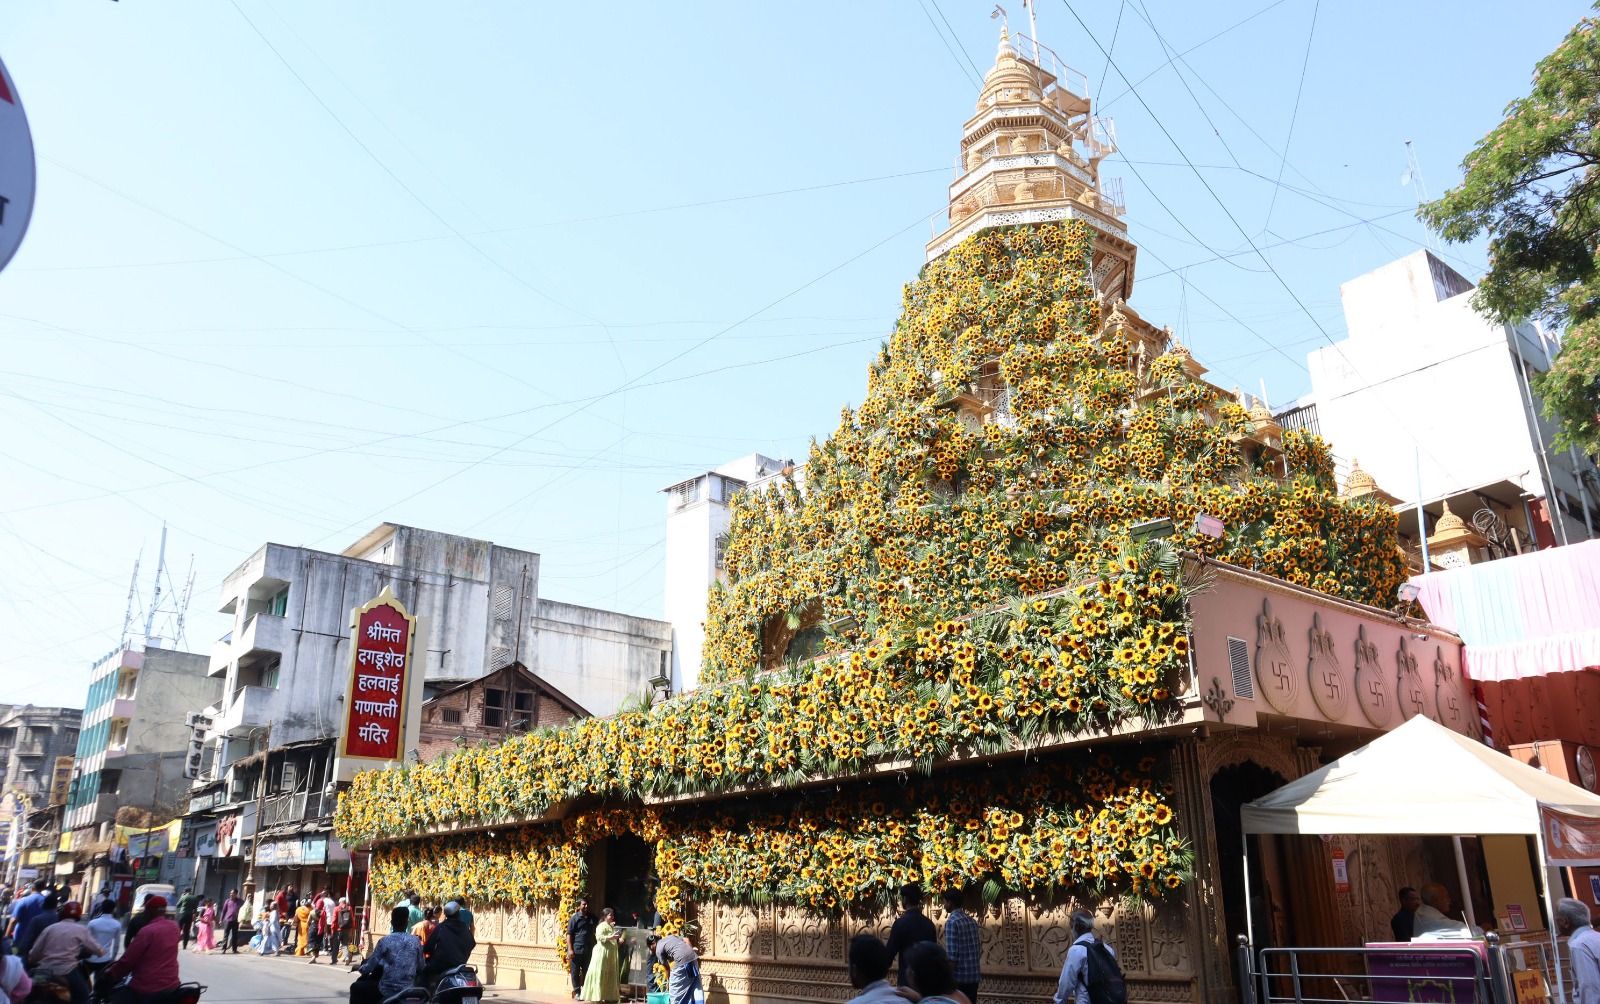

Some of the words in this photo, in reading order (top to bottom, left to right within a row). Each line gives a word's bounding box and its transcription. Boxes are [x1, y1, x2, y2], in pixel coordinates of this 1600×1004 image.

[366, 620, 402, 644] श्रीमंत
[358, 647, 405, 671] दगडूशेठ
[358, 673, 401, 695] हलवाई
[355, 699, 398, 719] गणपती
[358, 722, 389, 745] मंदिर
